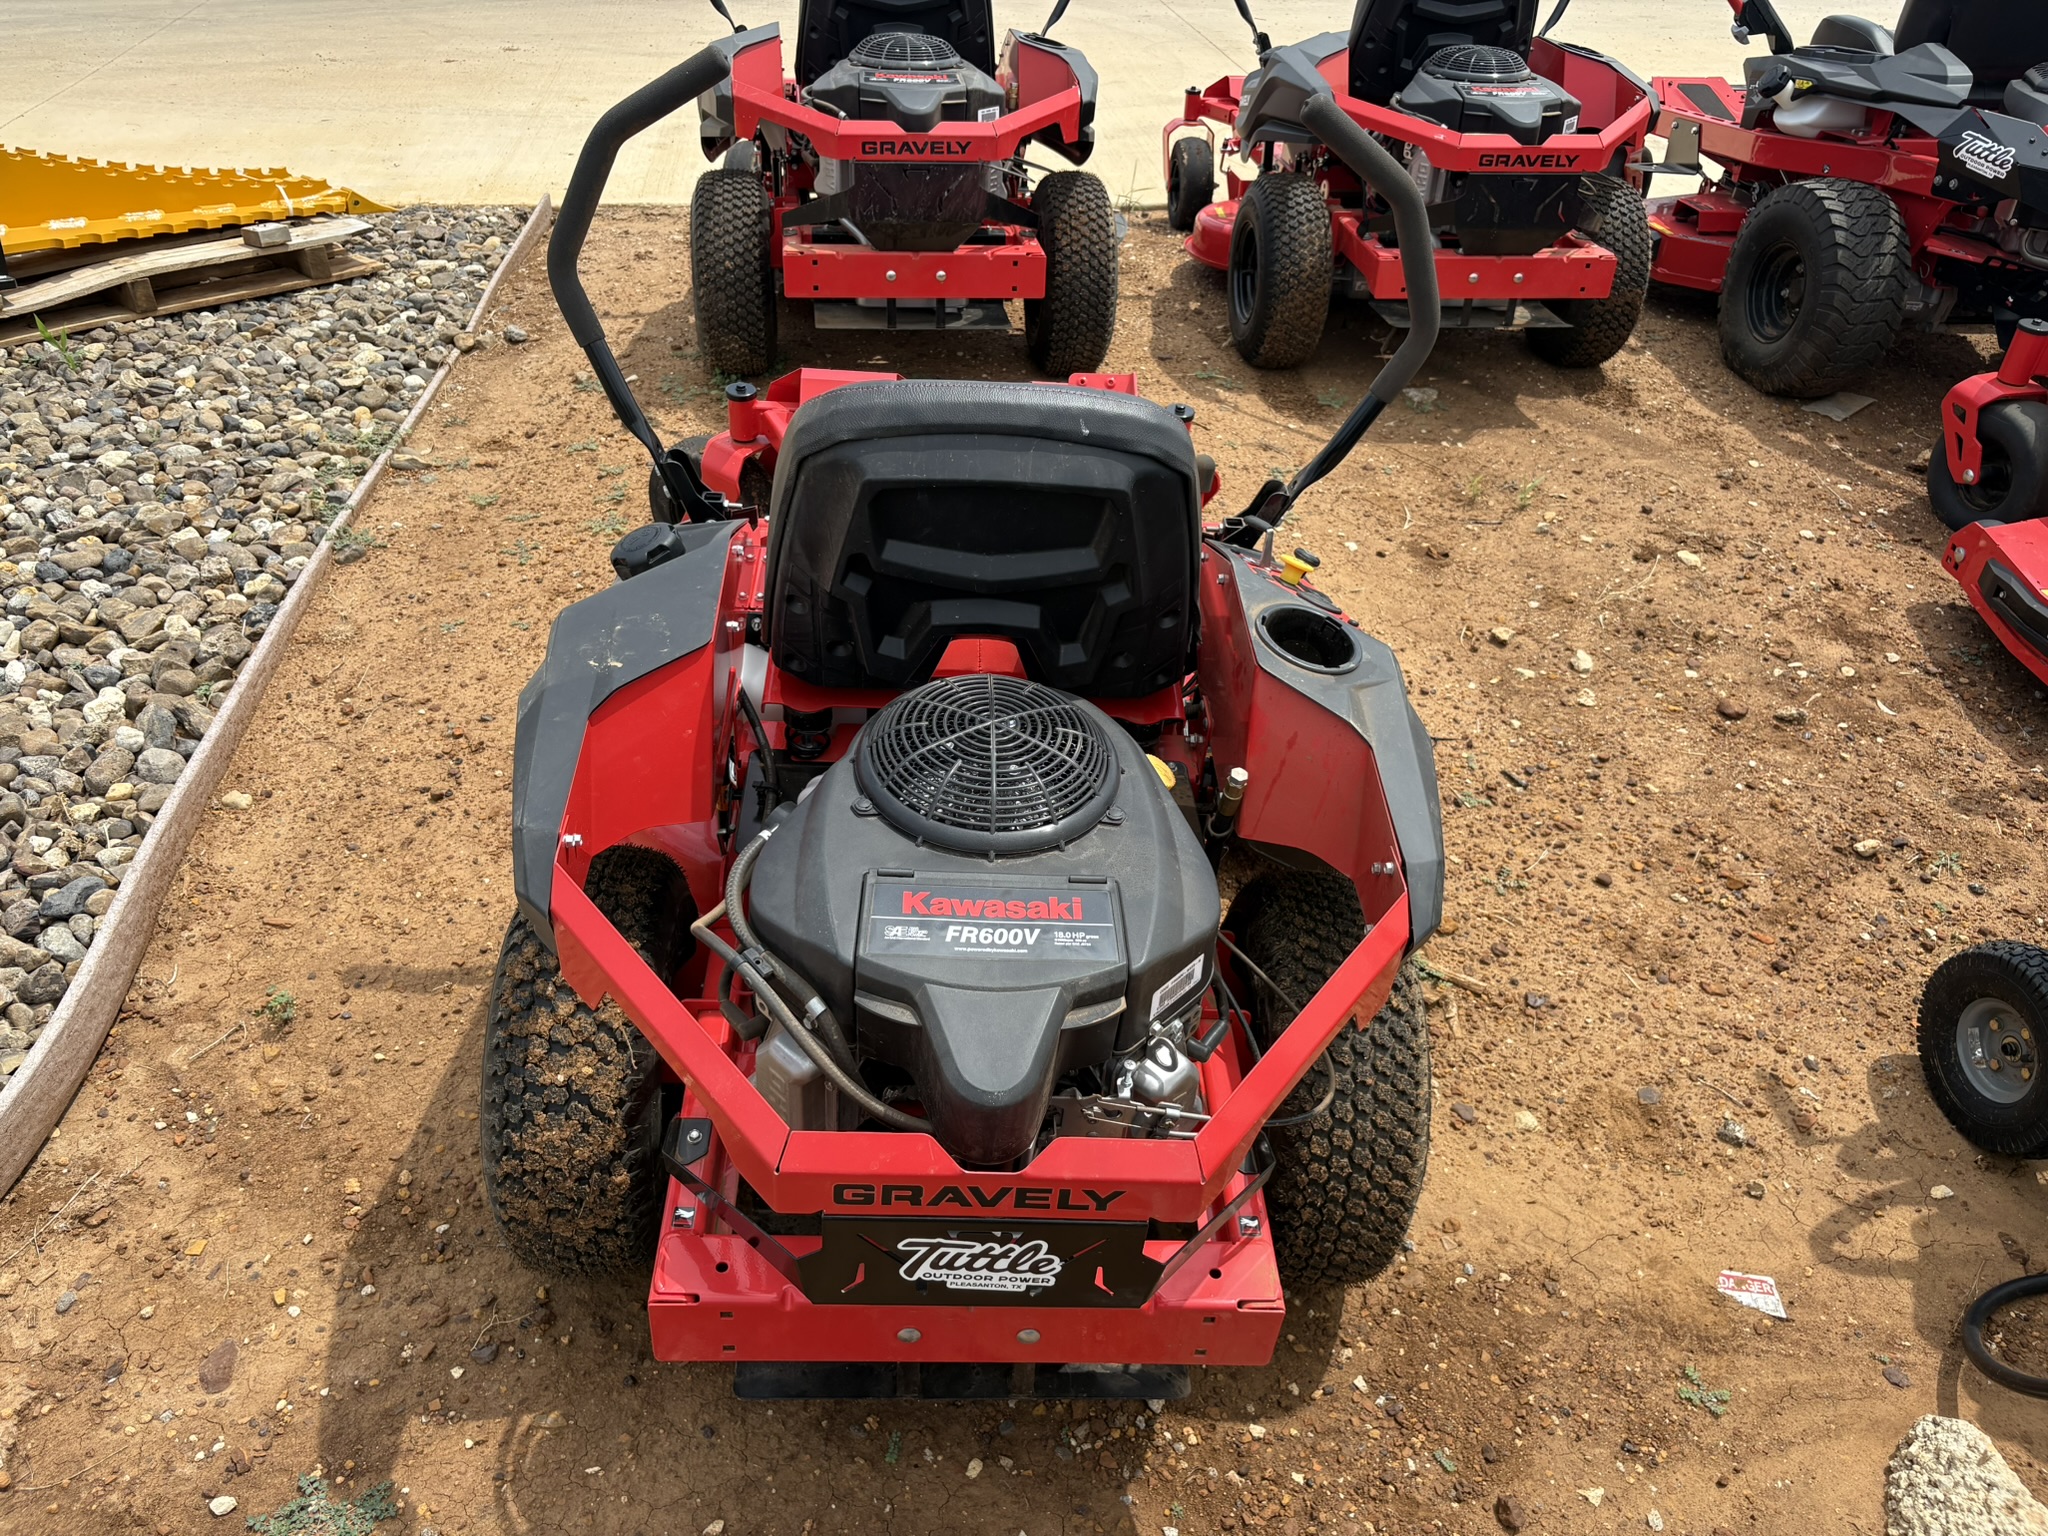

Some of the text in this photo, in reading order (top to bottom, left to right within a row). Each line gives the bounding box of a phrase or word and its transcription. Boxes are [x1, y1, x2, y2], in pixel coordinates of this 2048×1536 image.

[861, 141, 972, 155] GRAVELY
[1953, 131, 2015, 170] Tuttle
[1478, 154, 1580, 168] GRAVELY
[902, 891, 1083, 920] Kawasaki
[945, 926, 1041, 945] FR600V
[1053, 931, 1071, 939] 18.0
[1072, 931, 1085, 939] HP
[833, 1183, 1128, 1211] GRAVELY
[899, 1238, 1063, 1279] Tuttle
[922, 1272, 1051, 1285] OUTDOOR POWER
[950, 1281, 1011, 1290] PLEASANTON,
[1719, 1276, 1773, 1294] DAGER
